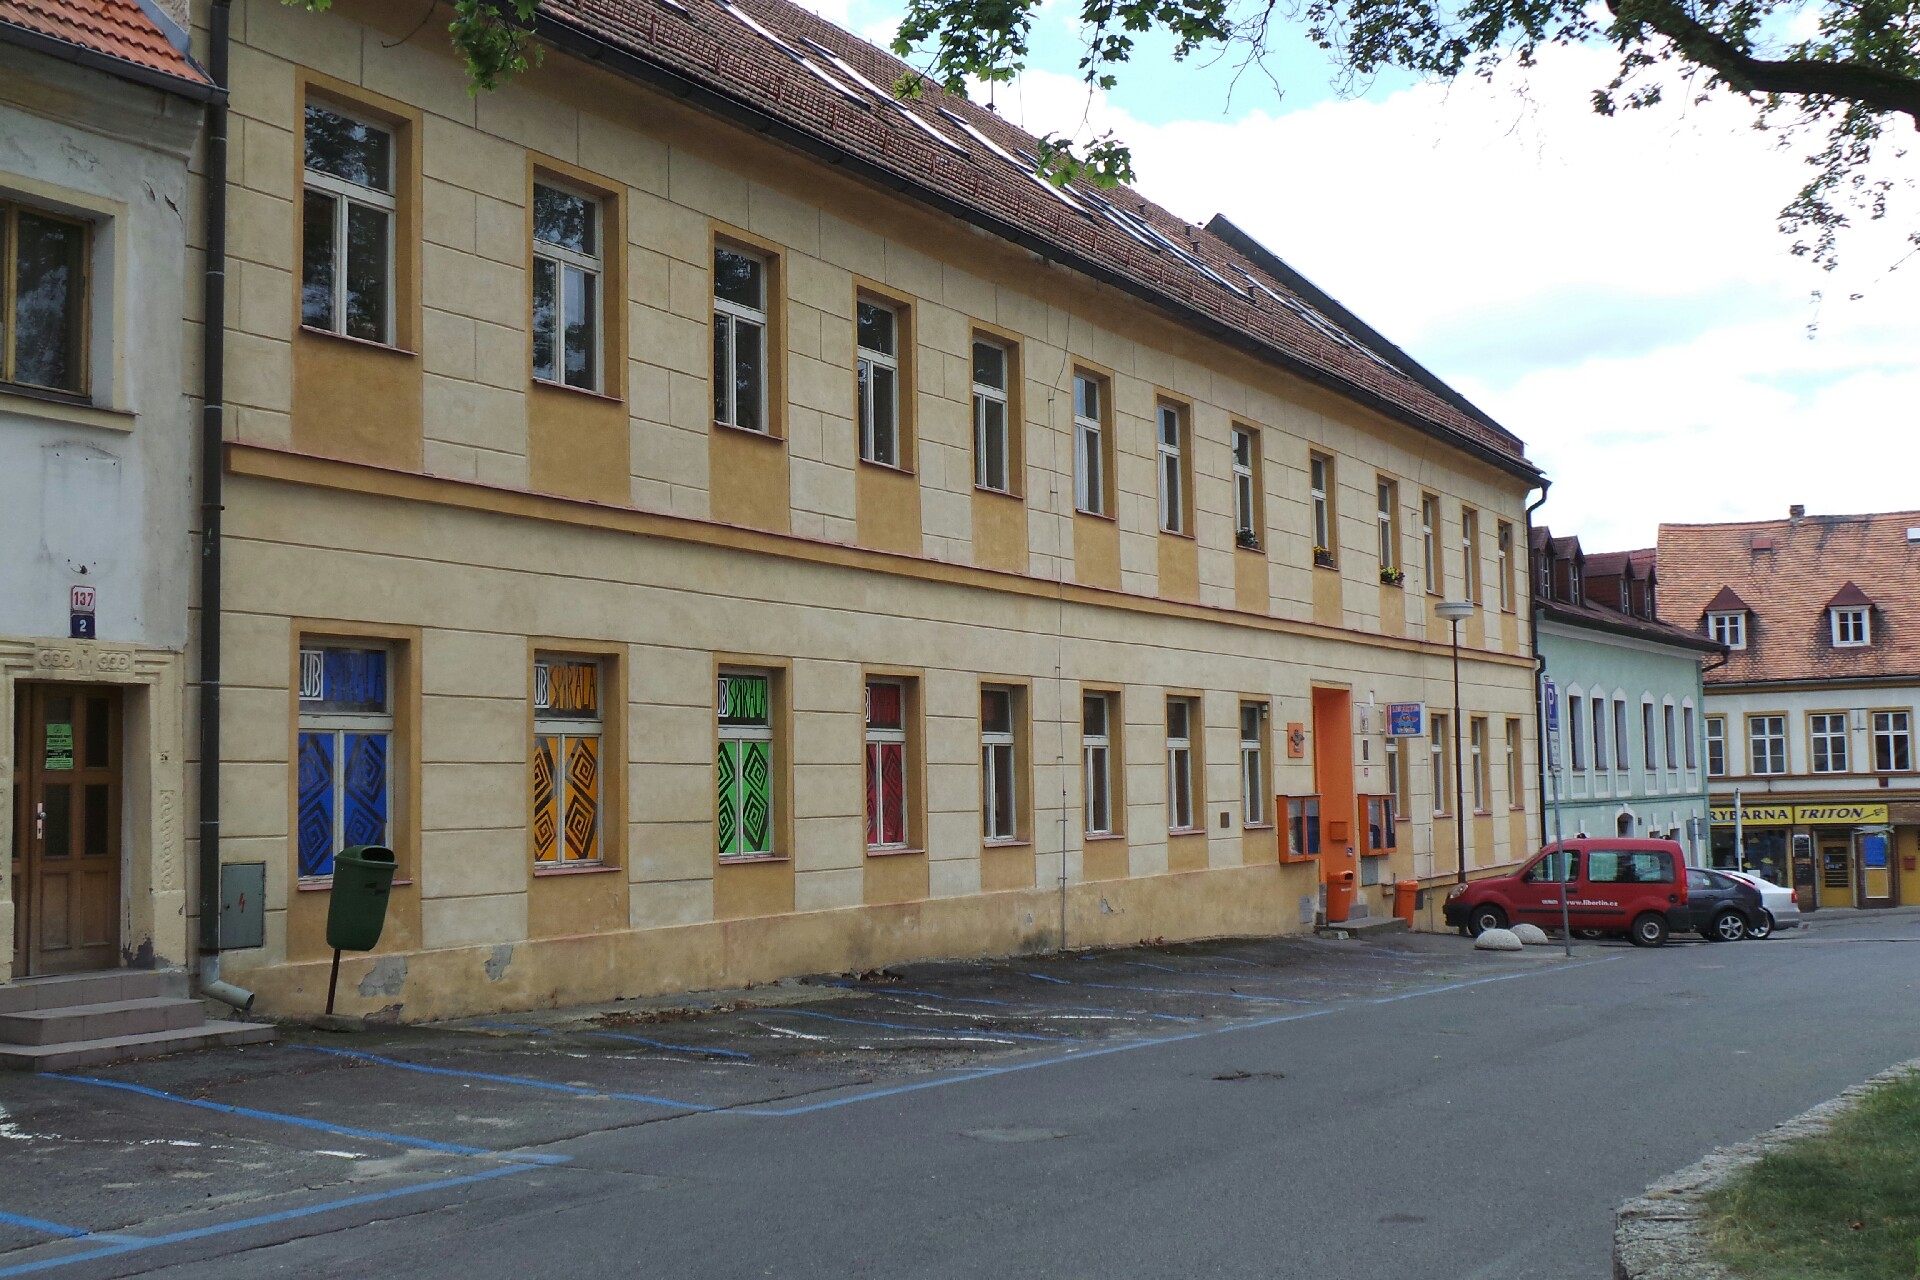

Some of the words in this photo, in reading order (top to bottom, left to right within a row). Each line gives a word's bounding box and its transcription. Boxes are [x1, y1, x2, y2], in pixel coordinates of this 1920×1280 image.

[73, 591, 94, 607] 137
[79, 619, 87, 632] 2
[1547, 687, 1555, 715] P
[1710, 807, 1788, 821] RYBÁRNA
[1800, 807, 1864, 819] TRITON
